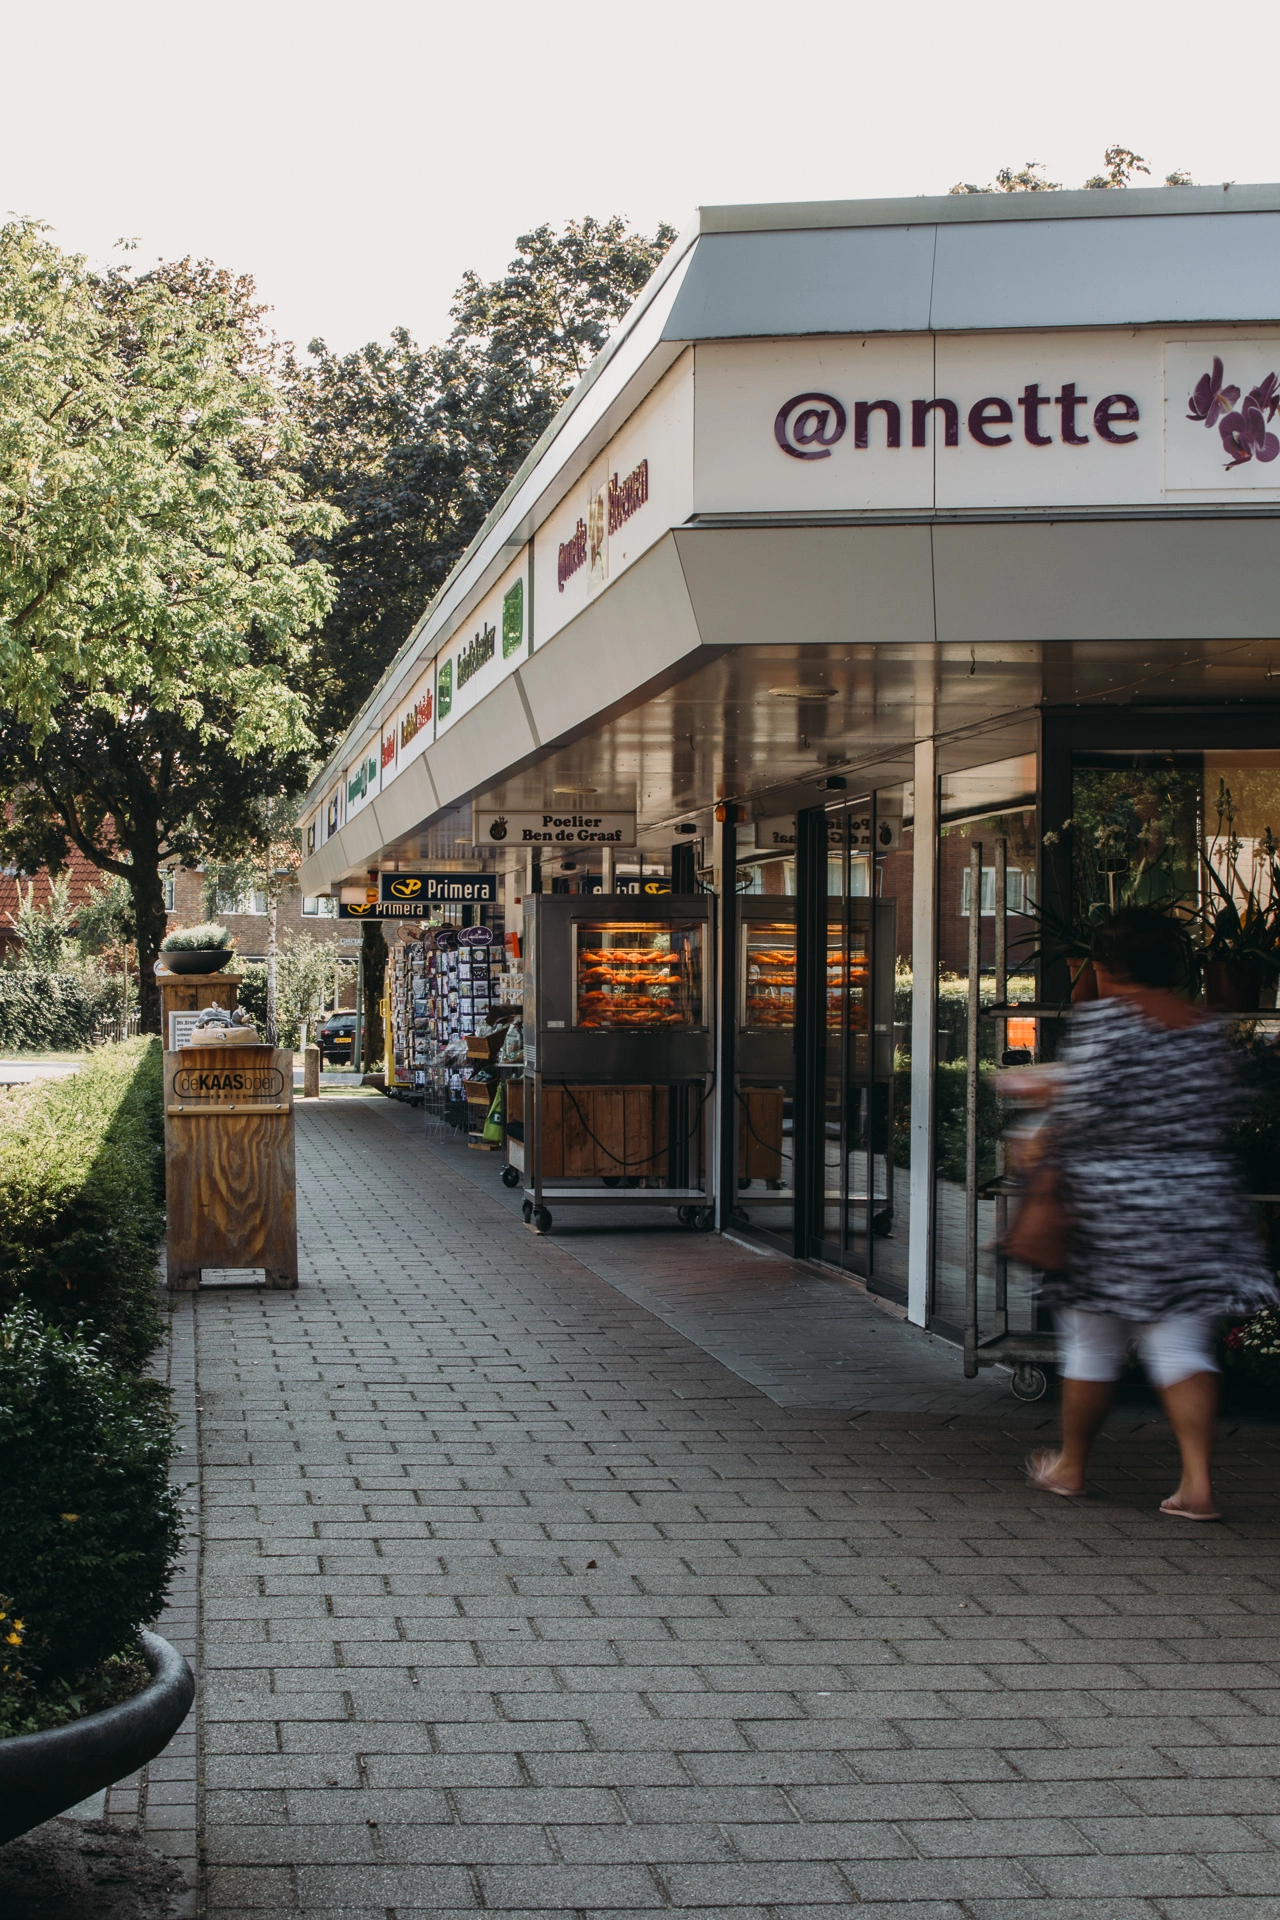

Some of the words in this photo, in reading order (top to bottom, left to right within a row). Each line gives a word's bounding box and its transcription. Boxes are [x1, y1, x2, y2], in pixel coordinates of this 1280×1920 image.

[773, 382, 1140, 460] @nnette
[542, 815, 602, 827] Poelier
[522, 829, 553, 841] Ben
[555, 829, 574, 841] de
[577, 829, 622, 841] Graaf
[428, 879, 490, 898] Primera
[181, 1073, 276, 1091] deKAASboer
